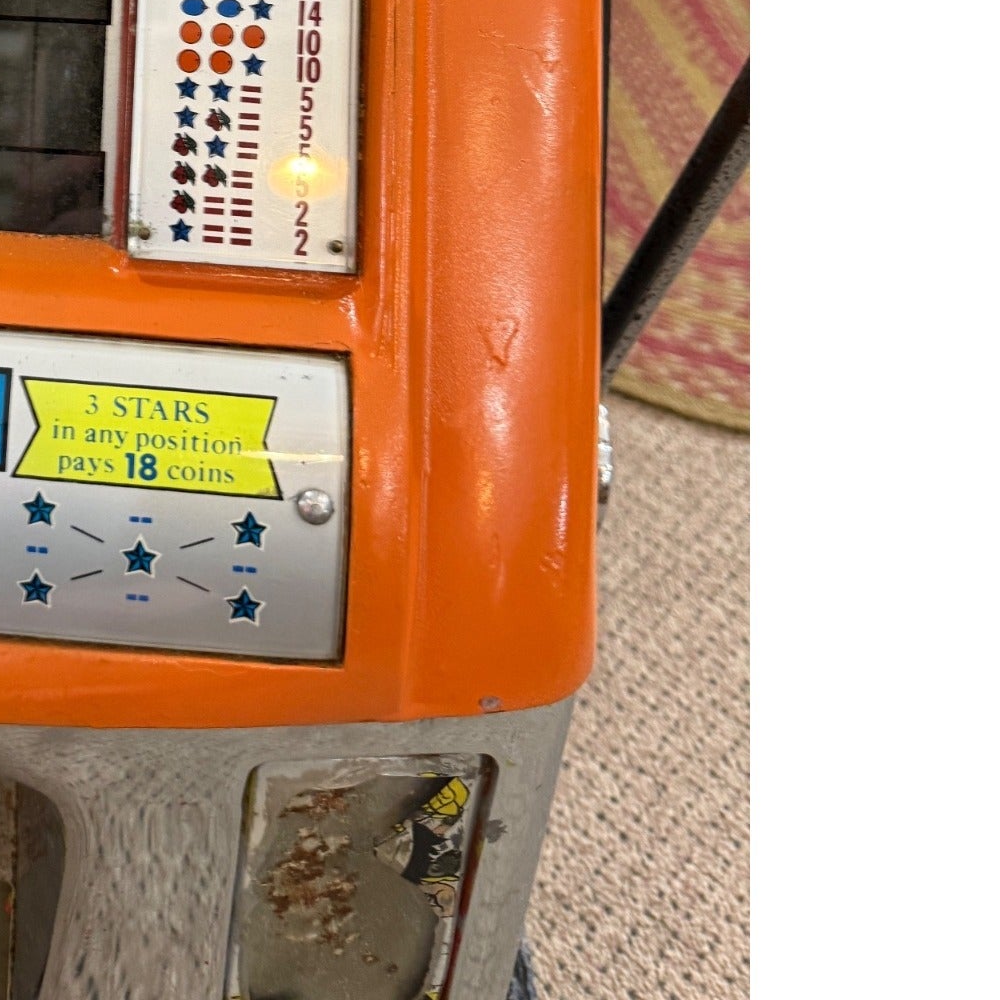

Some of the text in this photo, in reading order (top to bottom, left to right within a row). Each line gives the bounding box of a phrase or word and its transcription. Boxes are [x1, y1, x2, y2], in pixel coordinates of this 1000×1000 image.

[298, 1, 322, 27] 14
[297, 29, 321, 56] 10
[296, 56, 321, 83] 10
[300, 87, 313, 113] 5
[299, 115, 313, 141] 5
[294, 200, 309, 227] 2
[294, 229, 309, 256] 2
[85, 394, 210, 424] 3 STARS
[52, 418, 242, 456] in any position
[58, 452, 235, 483] pays 18 coins
